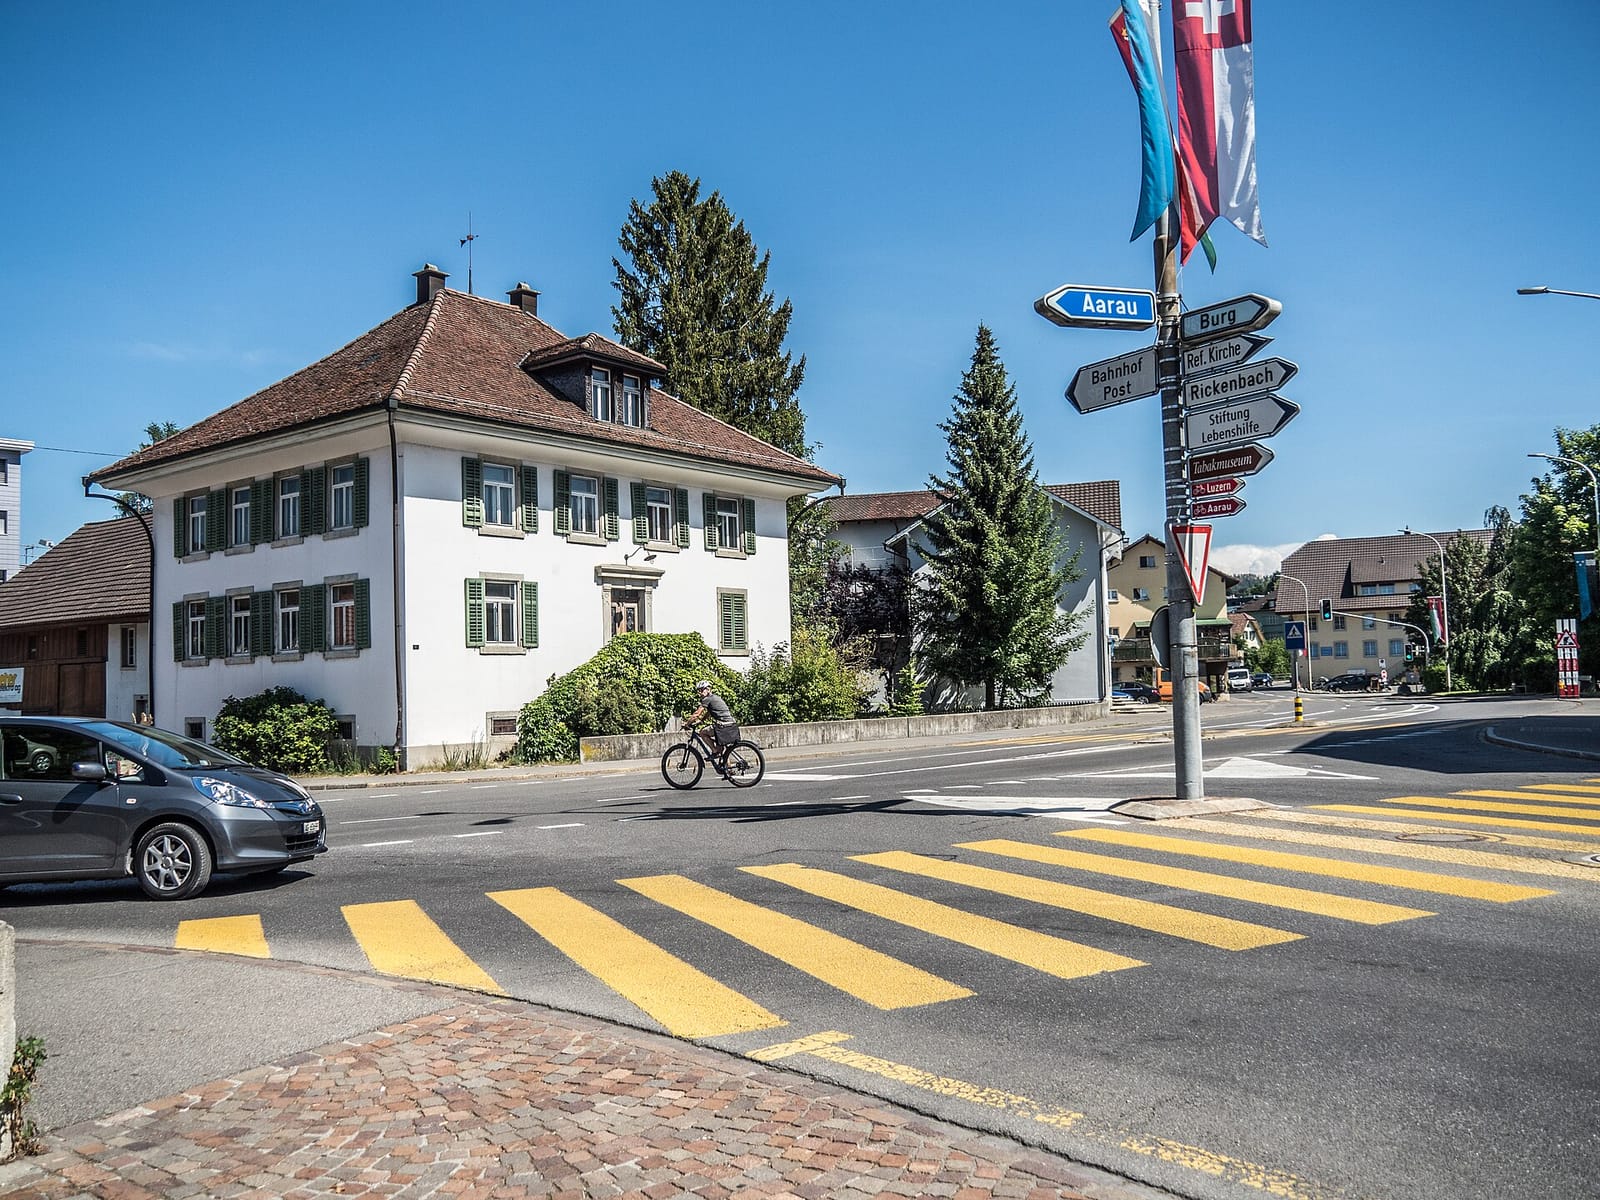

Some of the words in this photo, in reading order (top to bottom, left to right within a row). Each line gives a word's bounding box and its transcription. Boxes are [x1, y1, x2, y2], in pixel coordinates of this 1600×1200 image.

[1082, 293, 1138, 316] Aarau
[1200, 309, 1236, 329] Burg
[1187, 350, 1207, 369] Ref.
[1208, 342, 1242, 364] Kirche
[1091, 357, 1143, 385] Bahnhof
[1103, 380, 1132, 401] Post
[1190, 368, 1274, 400] Rickenbach
[1209, 408, 1250, 426] Stiftung
[1202, 420, 1260, 443] Lebenshilfe
[1192, 454, 1252, 475] Tabakmuseum
[1206, 481, 1232, 493] Luzern
[1207, 502, 1232, 513] Aarau
